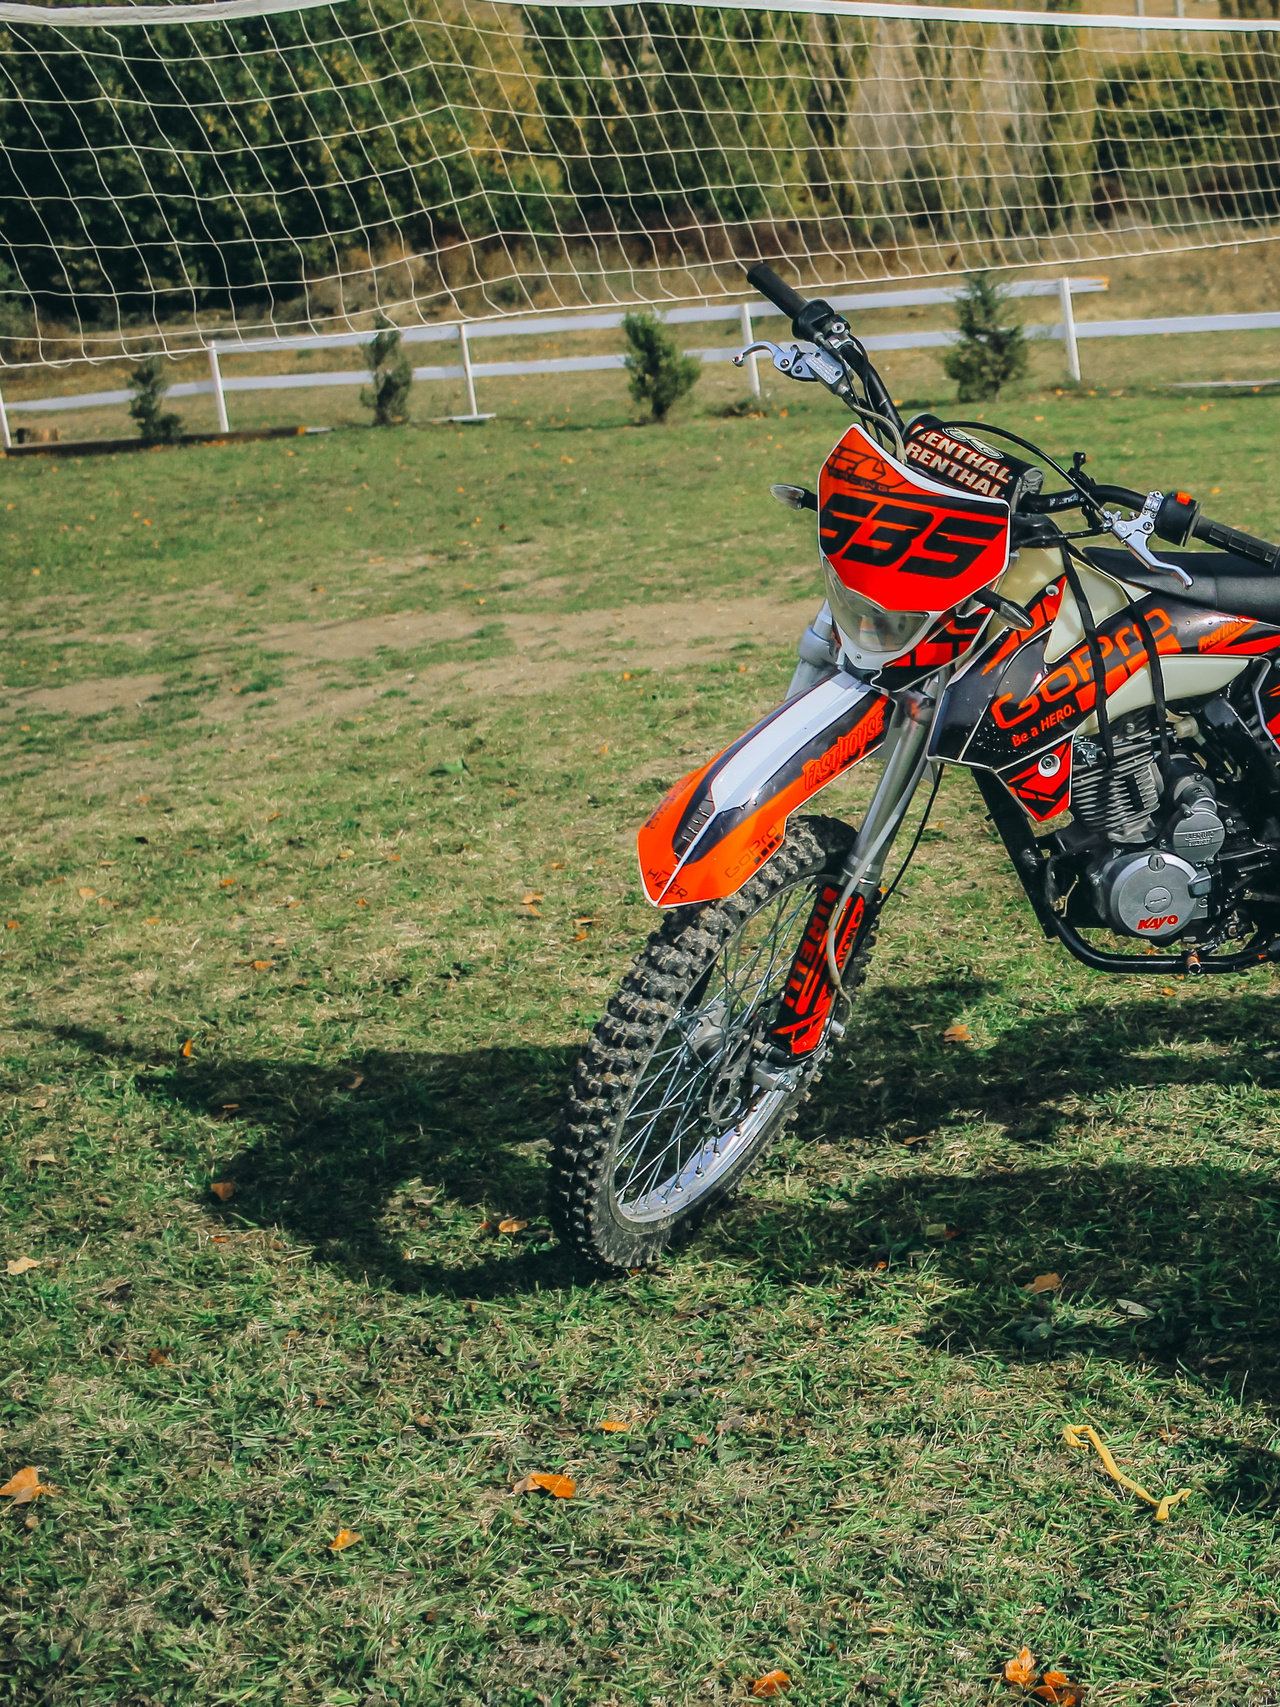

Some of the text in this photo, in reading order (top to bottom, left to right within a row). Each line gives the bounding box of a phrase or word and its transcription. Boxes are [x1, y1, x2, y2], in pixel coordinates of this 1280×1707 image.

[827, 468, 891, 493] RACING
[905, 442, 1002, 498] RENTHAL
[819, 492, 1007, 579] 535
[803, 710, 885, 790] FASTHOUSE
[1011, 704, 1075, 748] Be a HERO.
[725, 826, 778, 879] GoPro
